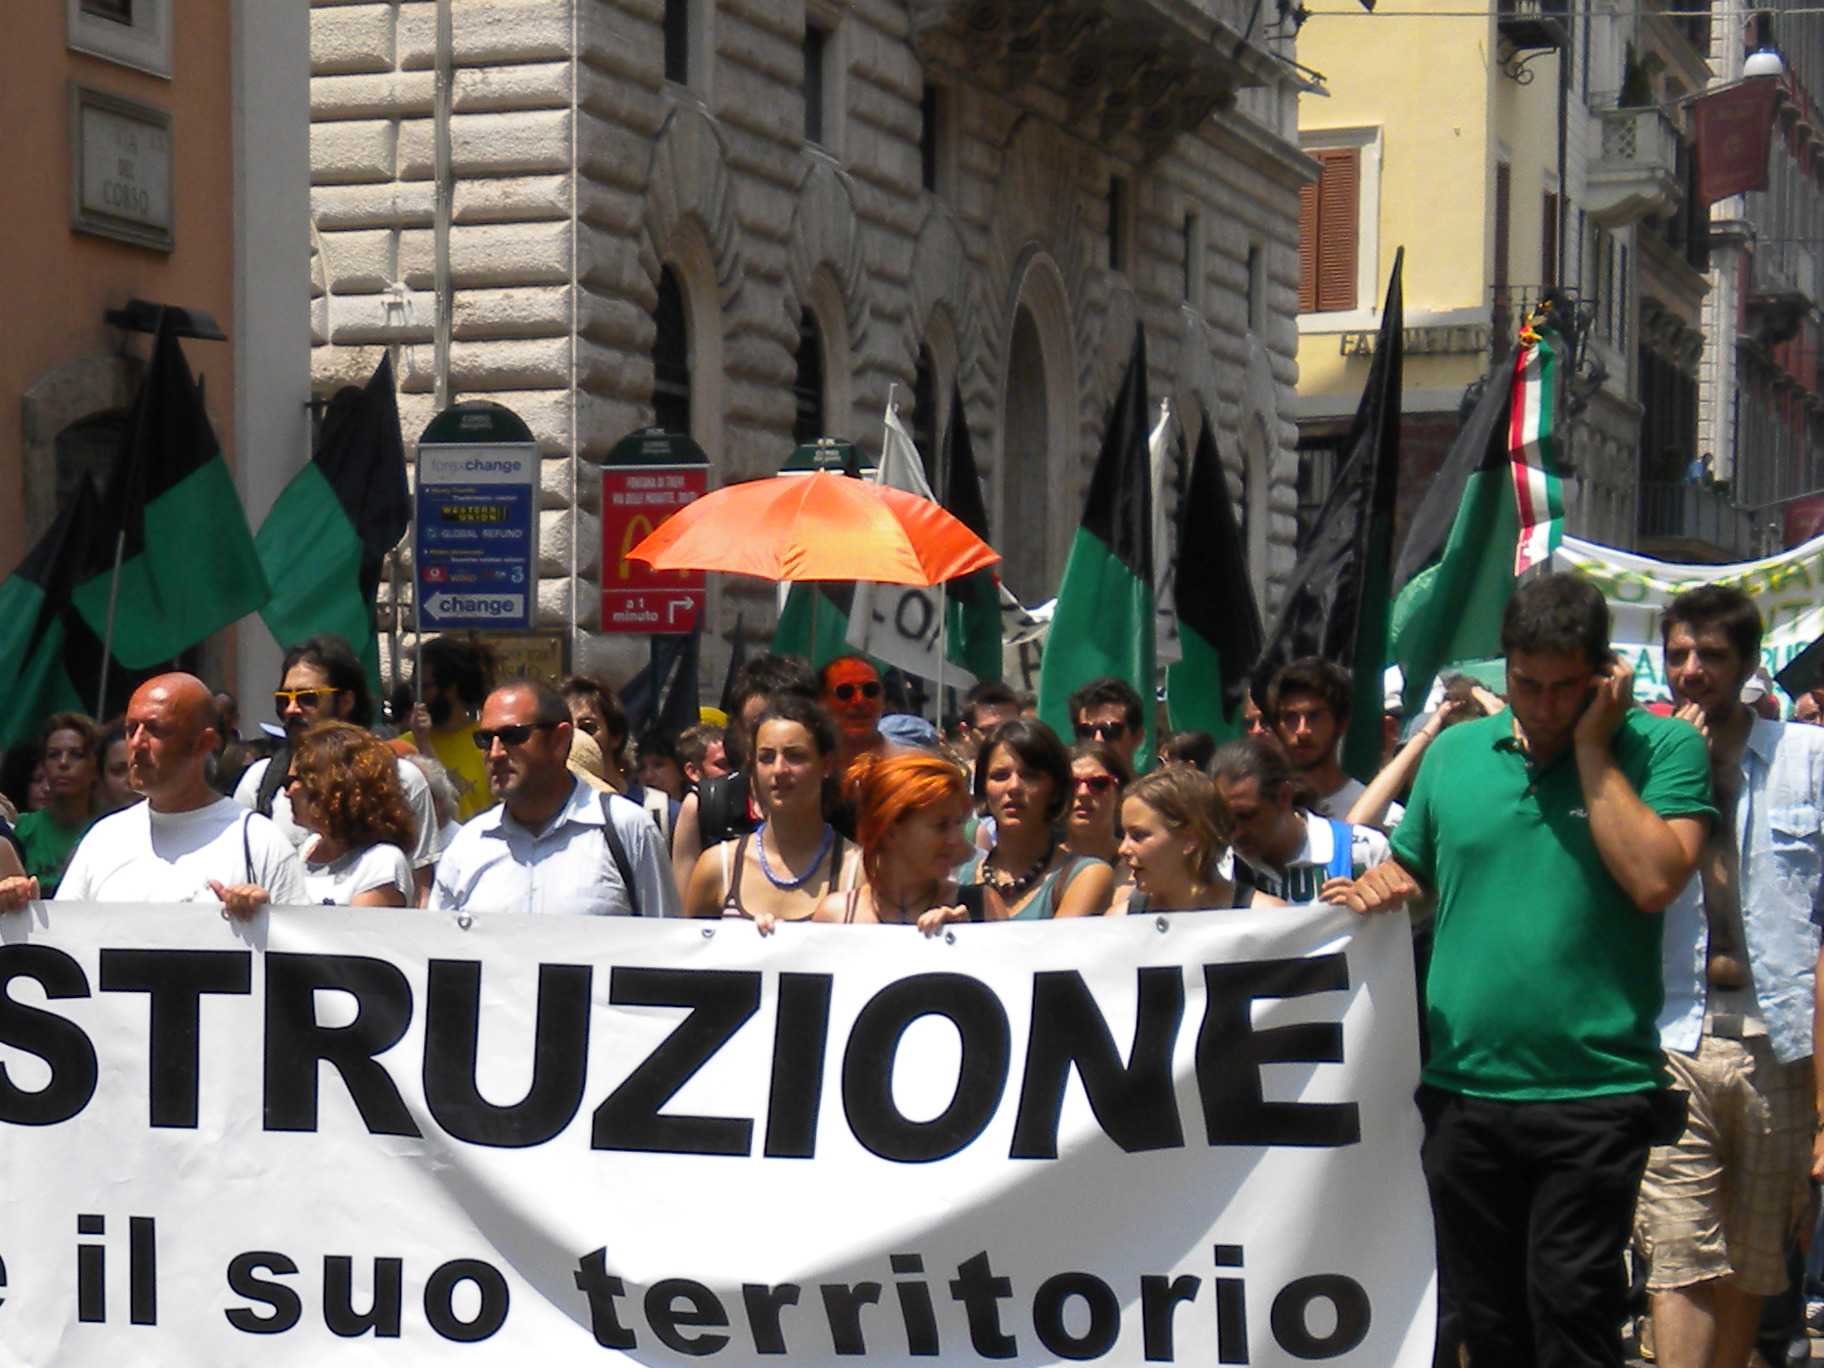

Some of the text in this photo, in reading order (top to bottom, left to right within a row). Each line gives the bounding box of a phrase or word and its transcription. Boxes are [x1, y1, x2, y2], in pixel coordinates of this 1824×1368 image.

[439, 596, 515, 615] change
[612, 610, 659, 622] minuto
[76, 1213, 158, 1327] il
[223, 1249, 512, 1344] suo
[572, 1243, 1373, 1366] territorio
